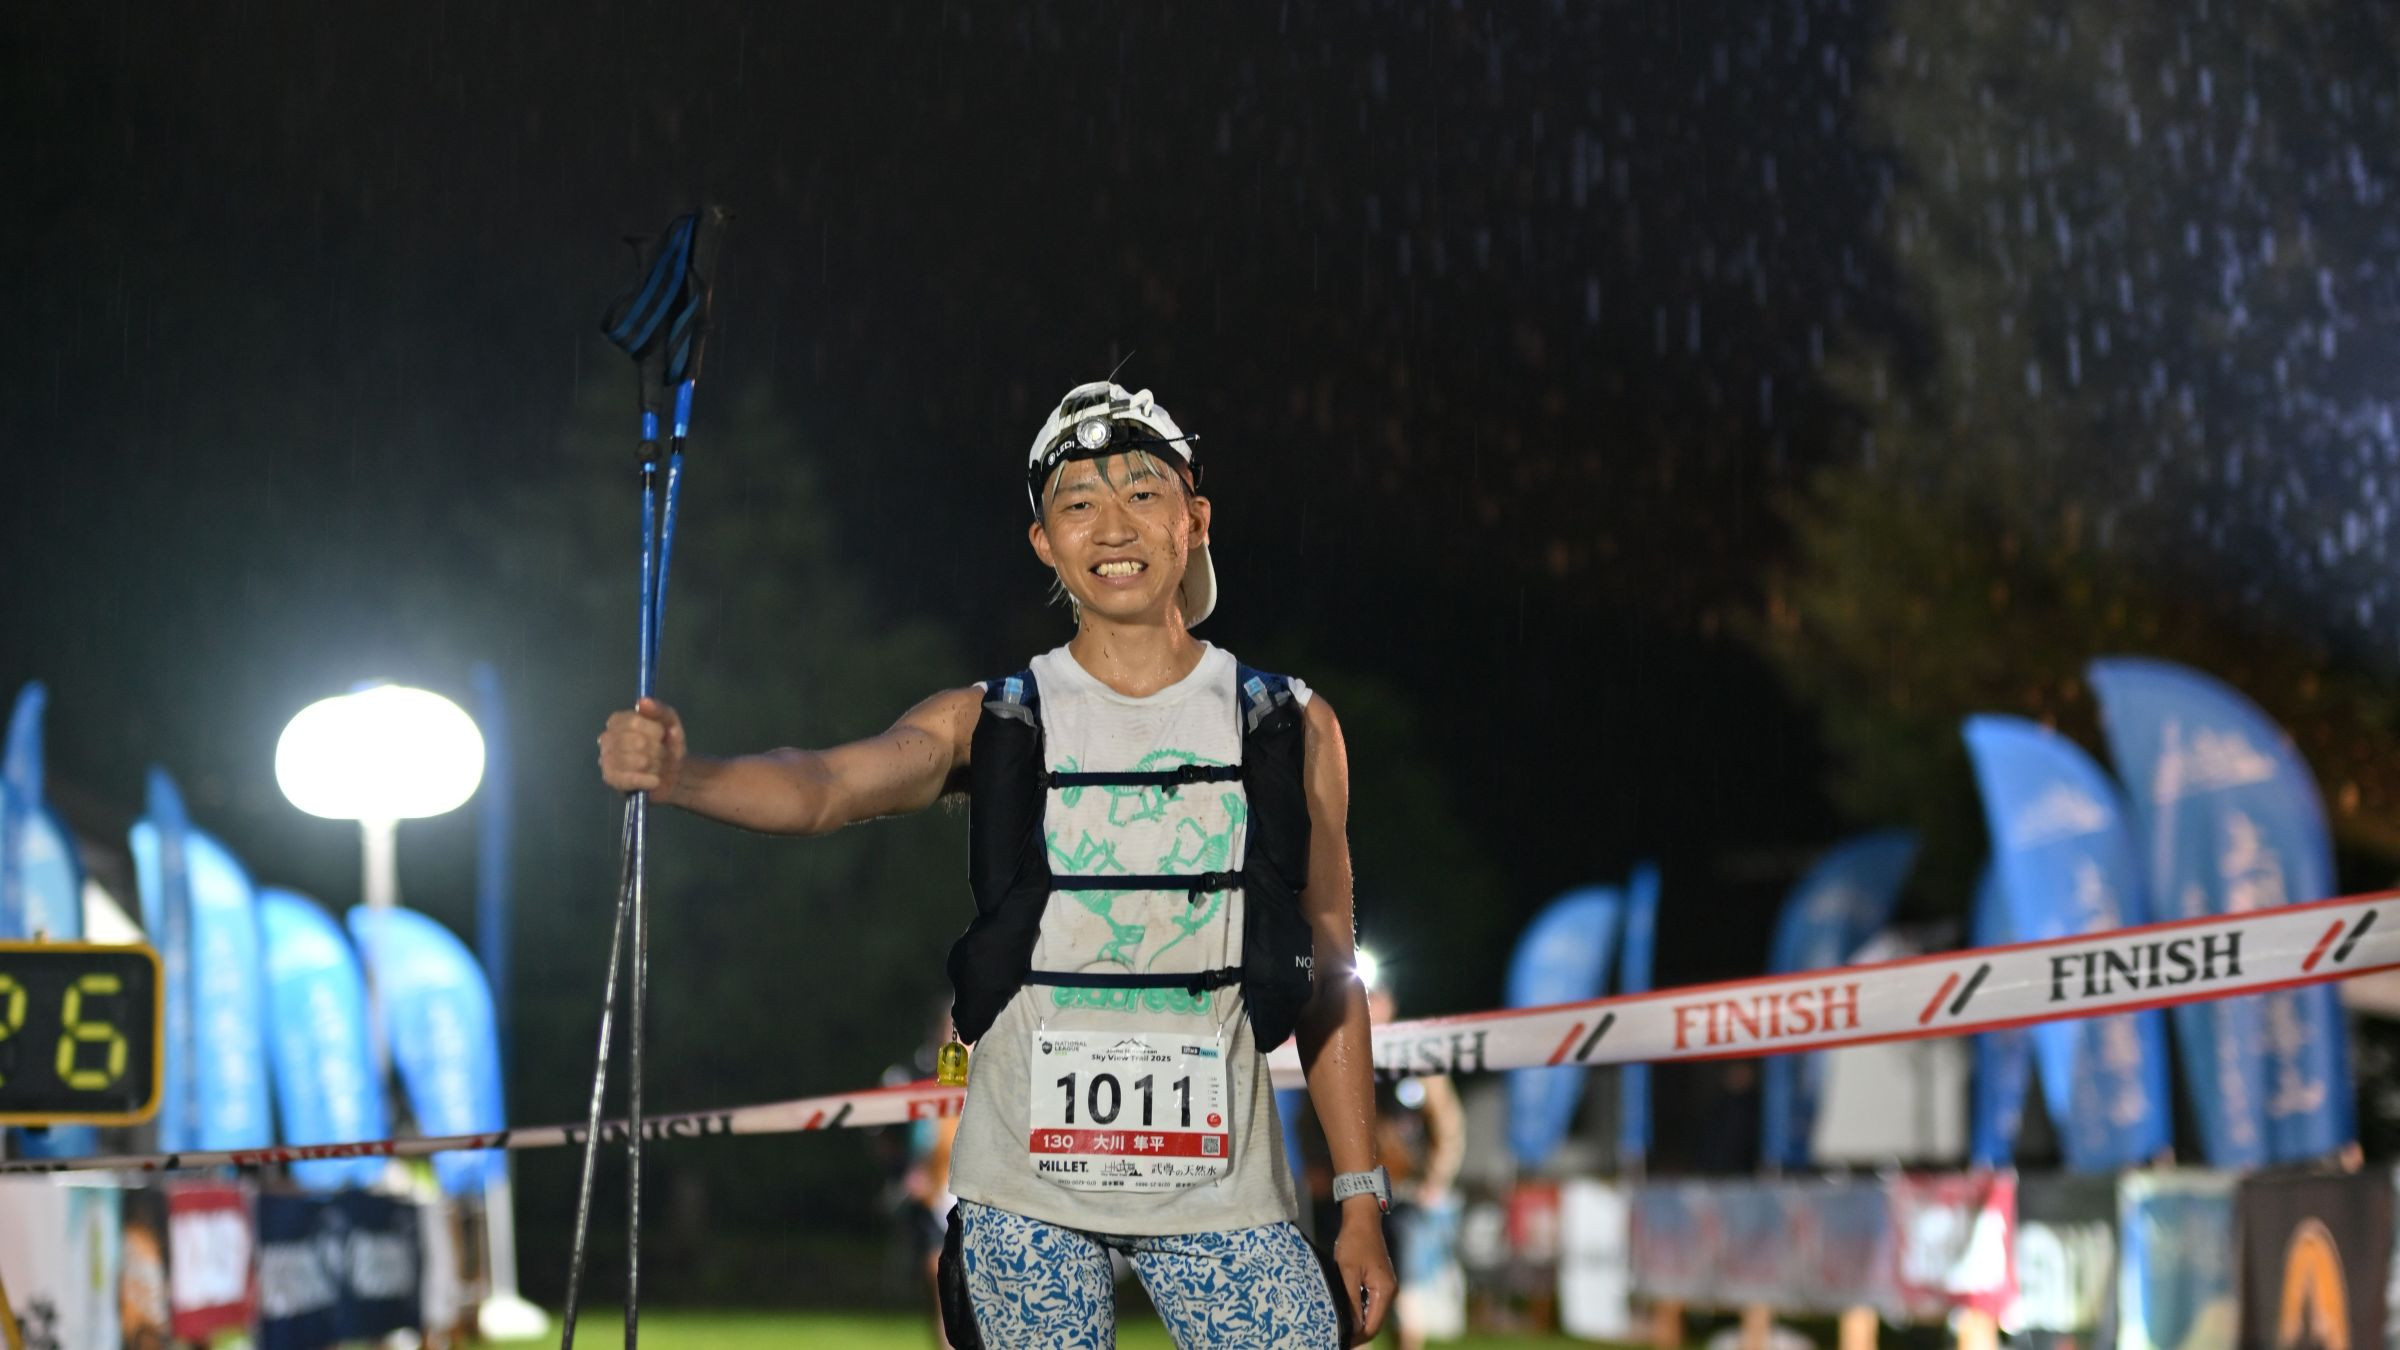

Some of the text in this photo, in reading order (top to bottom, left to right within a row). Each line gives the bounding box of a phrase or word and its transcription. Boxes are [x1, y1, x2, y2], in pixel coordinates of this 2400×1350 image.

[2049, 931, 2244, 1003] FINISH
[1673, 983, 1862, 1050] FINISH
[1091, 1054, 1106, 1062] Sky
[1108, 1054, 1128, 1062] View
[1056, 1072, 1191, 1127] 1011
[1043, 1134, 1075, 1148] 130
[1093, 1134, 1125, 1150] 大川
[1151, 1162, 1217, 1176] 武尊の天然水
